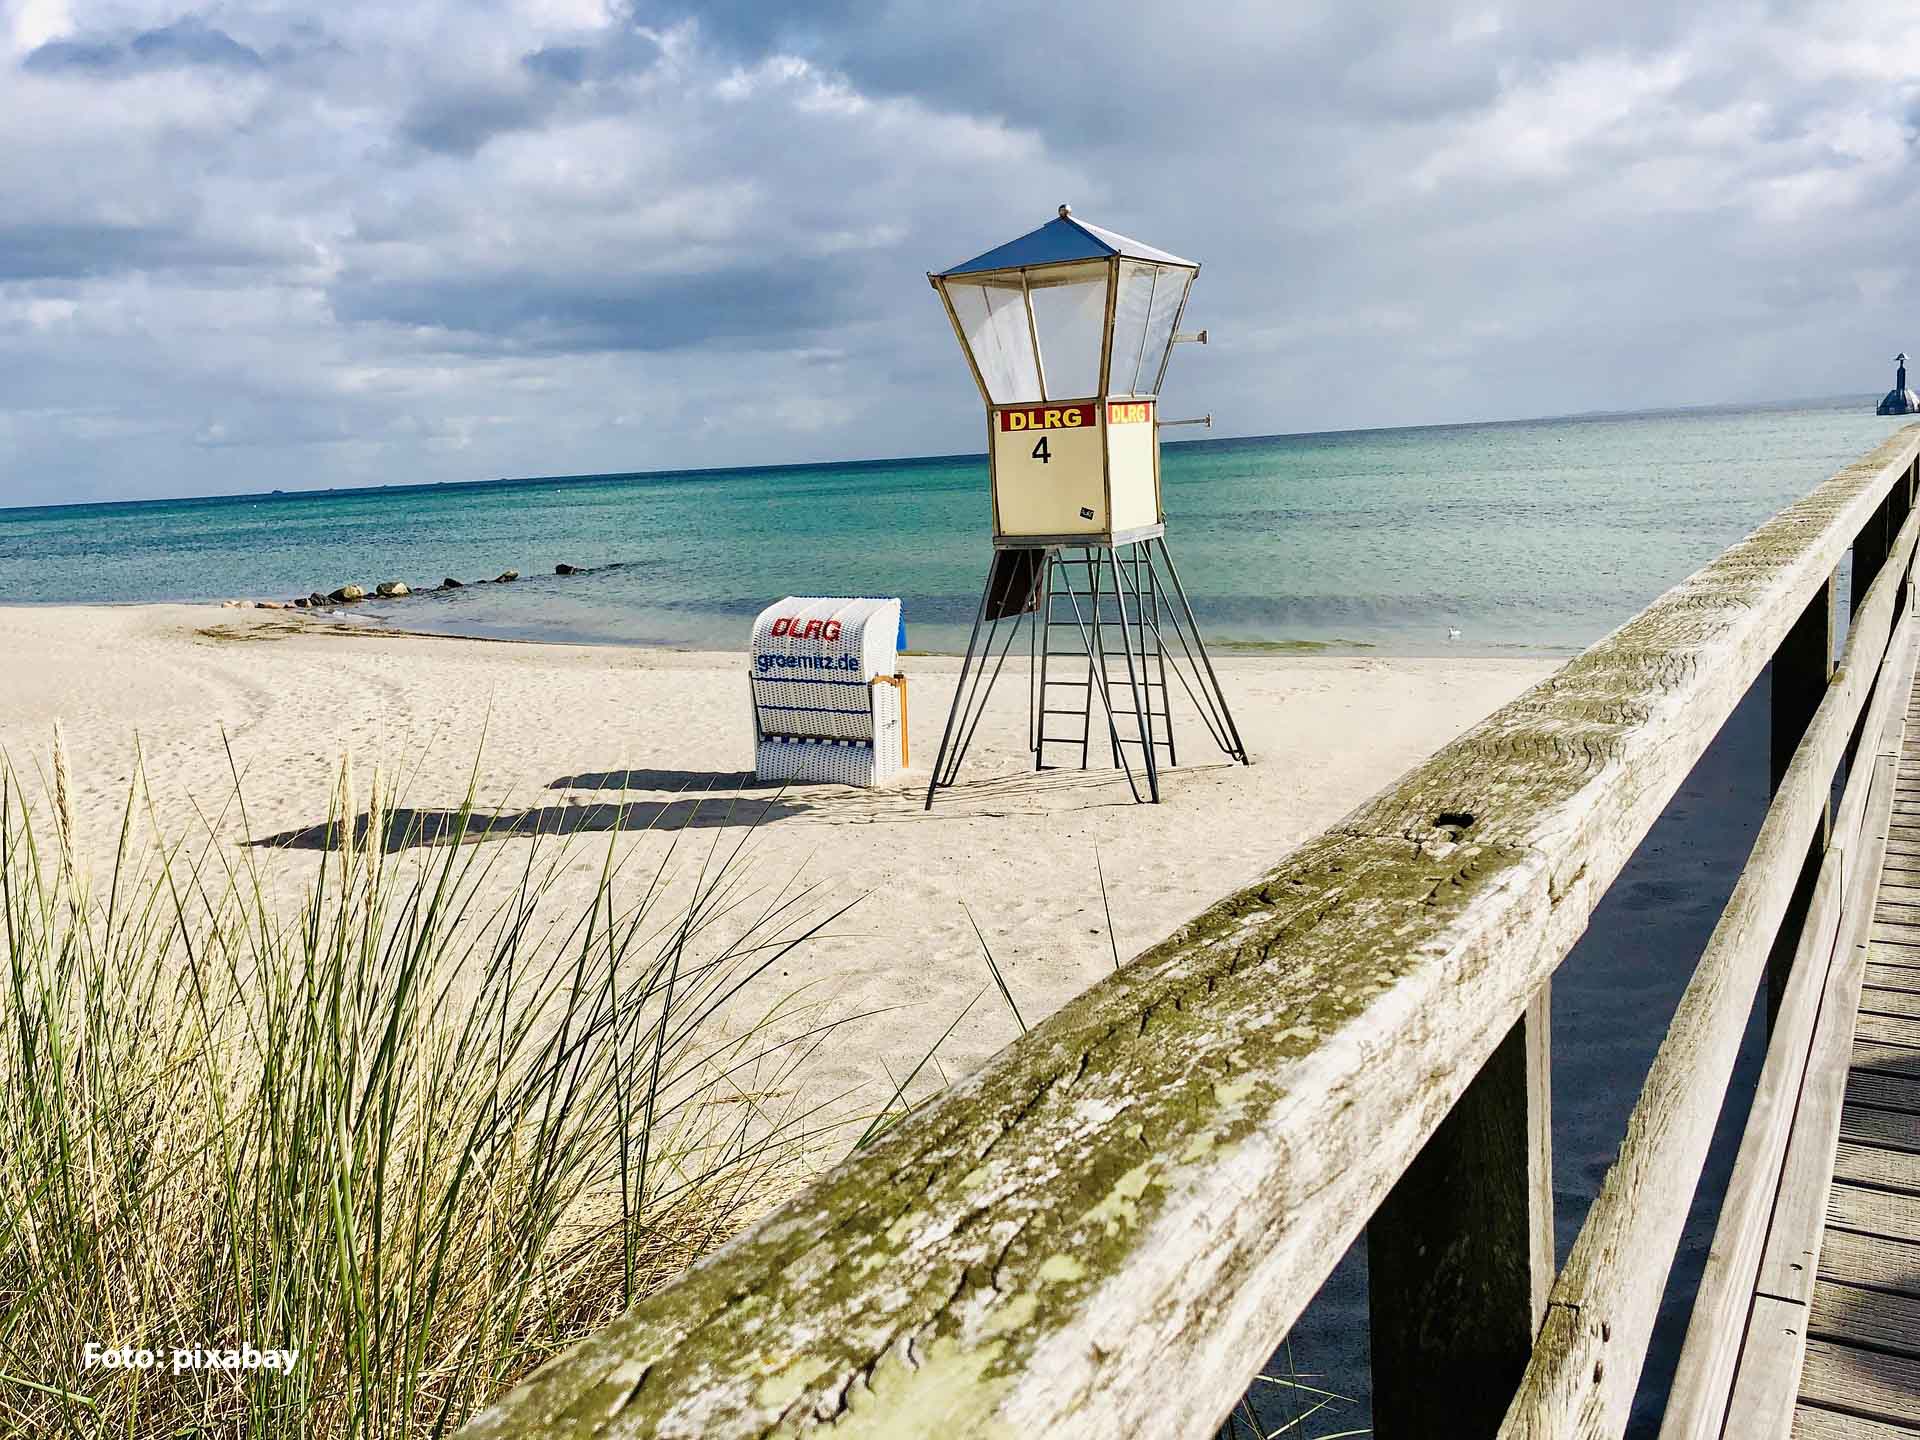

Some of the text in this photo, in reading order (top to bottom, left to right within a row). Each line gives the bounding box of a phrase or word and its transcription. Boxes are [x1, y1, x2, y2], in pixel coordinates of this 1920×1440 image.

[1009, 408, 1082, 430] DLRG
[1111, 403, 1146, 423] DLRG
[1031, 436, 1051, 463] 4
[771, 617, 842, 642] DLRG
[757, 653, 859, 672] groemitz.de
